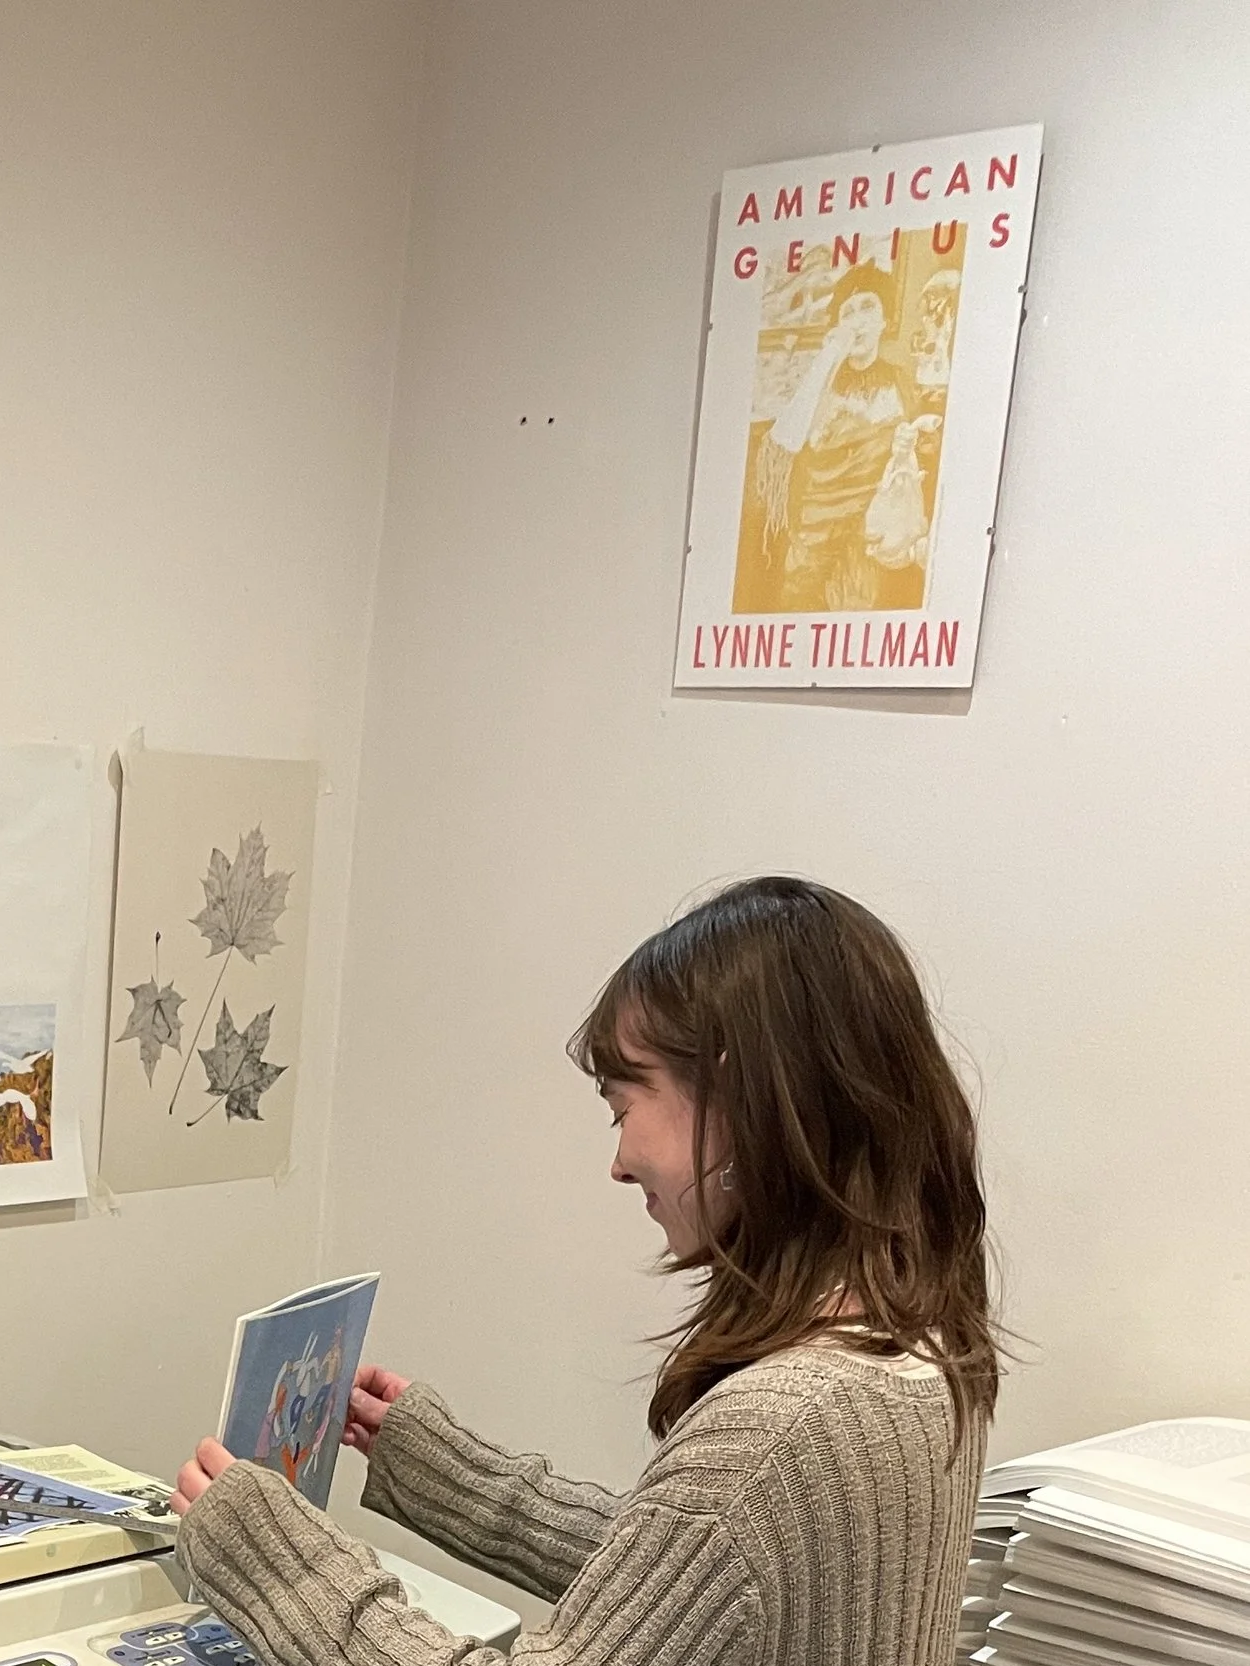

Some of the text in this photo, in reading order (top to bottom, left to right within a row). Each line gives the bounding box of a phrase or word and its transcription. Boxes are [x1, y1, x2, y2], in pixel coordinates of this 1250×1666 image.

[737, 153, 1019, 228] AMERICAN
[733, 211, 1012, 280] GENIUS
[693, 620, 960, 670] LYNNE TILLMAN
